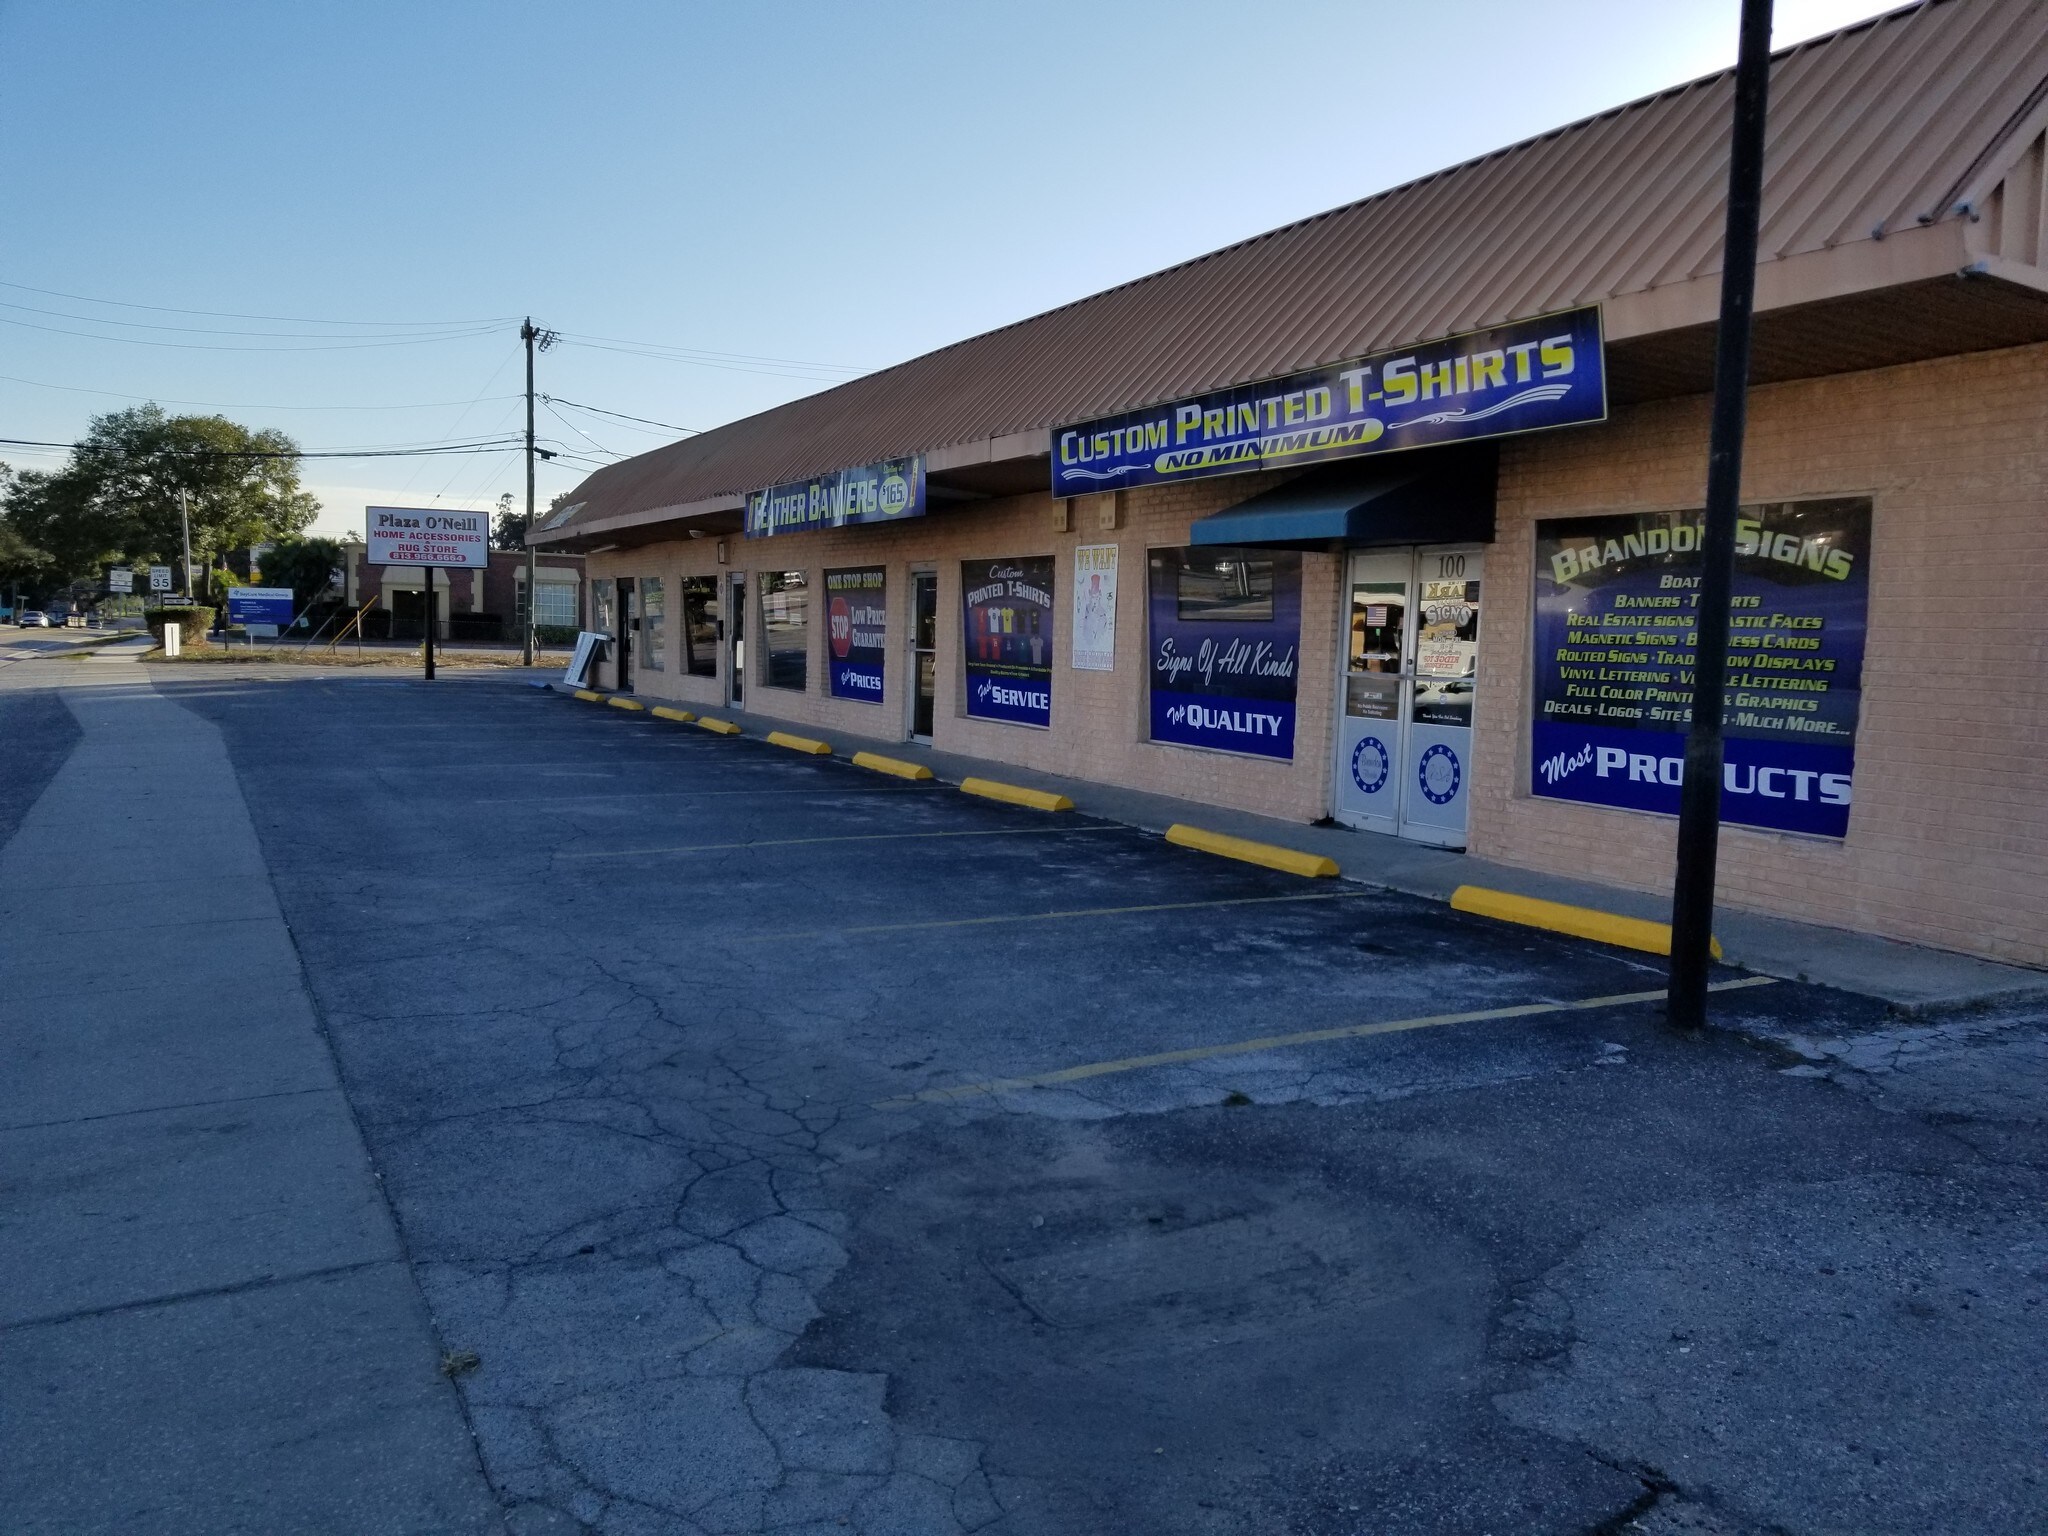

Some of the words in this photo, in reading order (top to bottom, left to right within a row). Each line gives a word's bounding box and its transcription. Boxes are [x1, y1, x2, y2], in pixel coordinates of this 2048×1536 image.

[1060, 418, 1168, 466] CUSTOM
[1175, 385, 1332, 446] PRINTED
[1338, 333, 1576, 415] T-SHIRTS
[1166, 450, 1205, 470] NO
[1207, 422, 1368, 461] MINIMUM
[378, 513, 420, 529] Plaza
[425, 516, 478, 532] O'Neill
[374, 530, 406, 539] HOME
[409, 532, 481, 543] ACCESSORIES
[398, 543, 420, 552] RUG
[423, 545, 458, 554] STORE
[1551, 525, 1706, 585] BRANDO
[1735, 518, 1854, 581] SIGNS
[989, 564, 1024, 579] Custom
[1438, 555, 1466, 579] 100
[153, 578, 169, 588] 35
[828, 573, 843, 590] ONE
[843, 573, 862, 589] STOP
[863, 572, 883, 588] SHOP
[967, 582, 1004, 609] PRINTED
[1006, 580, 1050, 609] T-SHIRTS
[1614, 594, 1681, 608] BANNERS
[831, 614, 849, 640] STOP
[851, 605, 866, 626] LOW
[1425, 604, 1473, 627] SIGNS
[1566, 613, 1600, 627] REAL
[1603, 613, 1651, 627] ESTATE
[1653, 615, 1695, 628] SIGNS
[1769, 613, 1823, 629] FACES
[1567, 631, 1633, 645] MAGNETIC
[1635, 631, 1678, 646] SIGNS
[1762, 633, 1821, 650] CARDS
[1157, 637, 1193, 684] Signs
[1198, 637, 1219, 686] Of
[1218, 637, 1251, 676] All
[1250, 640, 1294, 678] Kinds
[1556, 649, 1606, 663] ROUTED
[1607, 650, 1649, 664] SIGNS
[1753, 653, 1836, 672] DISPLAYS
[850, 671, 882, 691] PRICES
[1560, 666, 1596, 680] VINYL
[1599, 667, 1671, 684] LETTERING
[1740, 673, 1829, 692] LETTERING
[992, 686, 1049, 710] SERVICE
[1566, 684, 1597, 698] FULL
[1599, 685, 1644, 700] COLOR
[1735, 692, 1820, 712] GRAPHICS
[1167, 704, 1185, 725] Top
[1186, 704, 1283, 737] QUALITY
[1544, 700, 1592, 715] DECALS
[1598, 703, 1643, 719] LOGOS
[1649, 706, 1682, 722] SITE
[1735, 712, 1784, 730] MUCH
[1540, 743, 1593, 785] Most
[1596, 746, 1852, 806] PROUCTS
